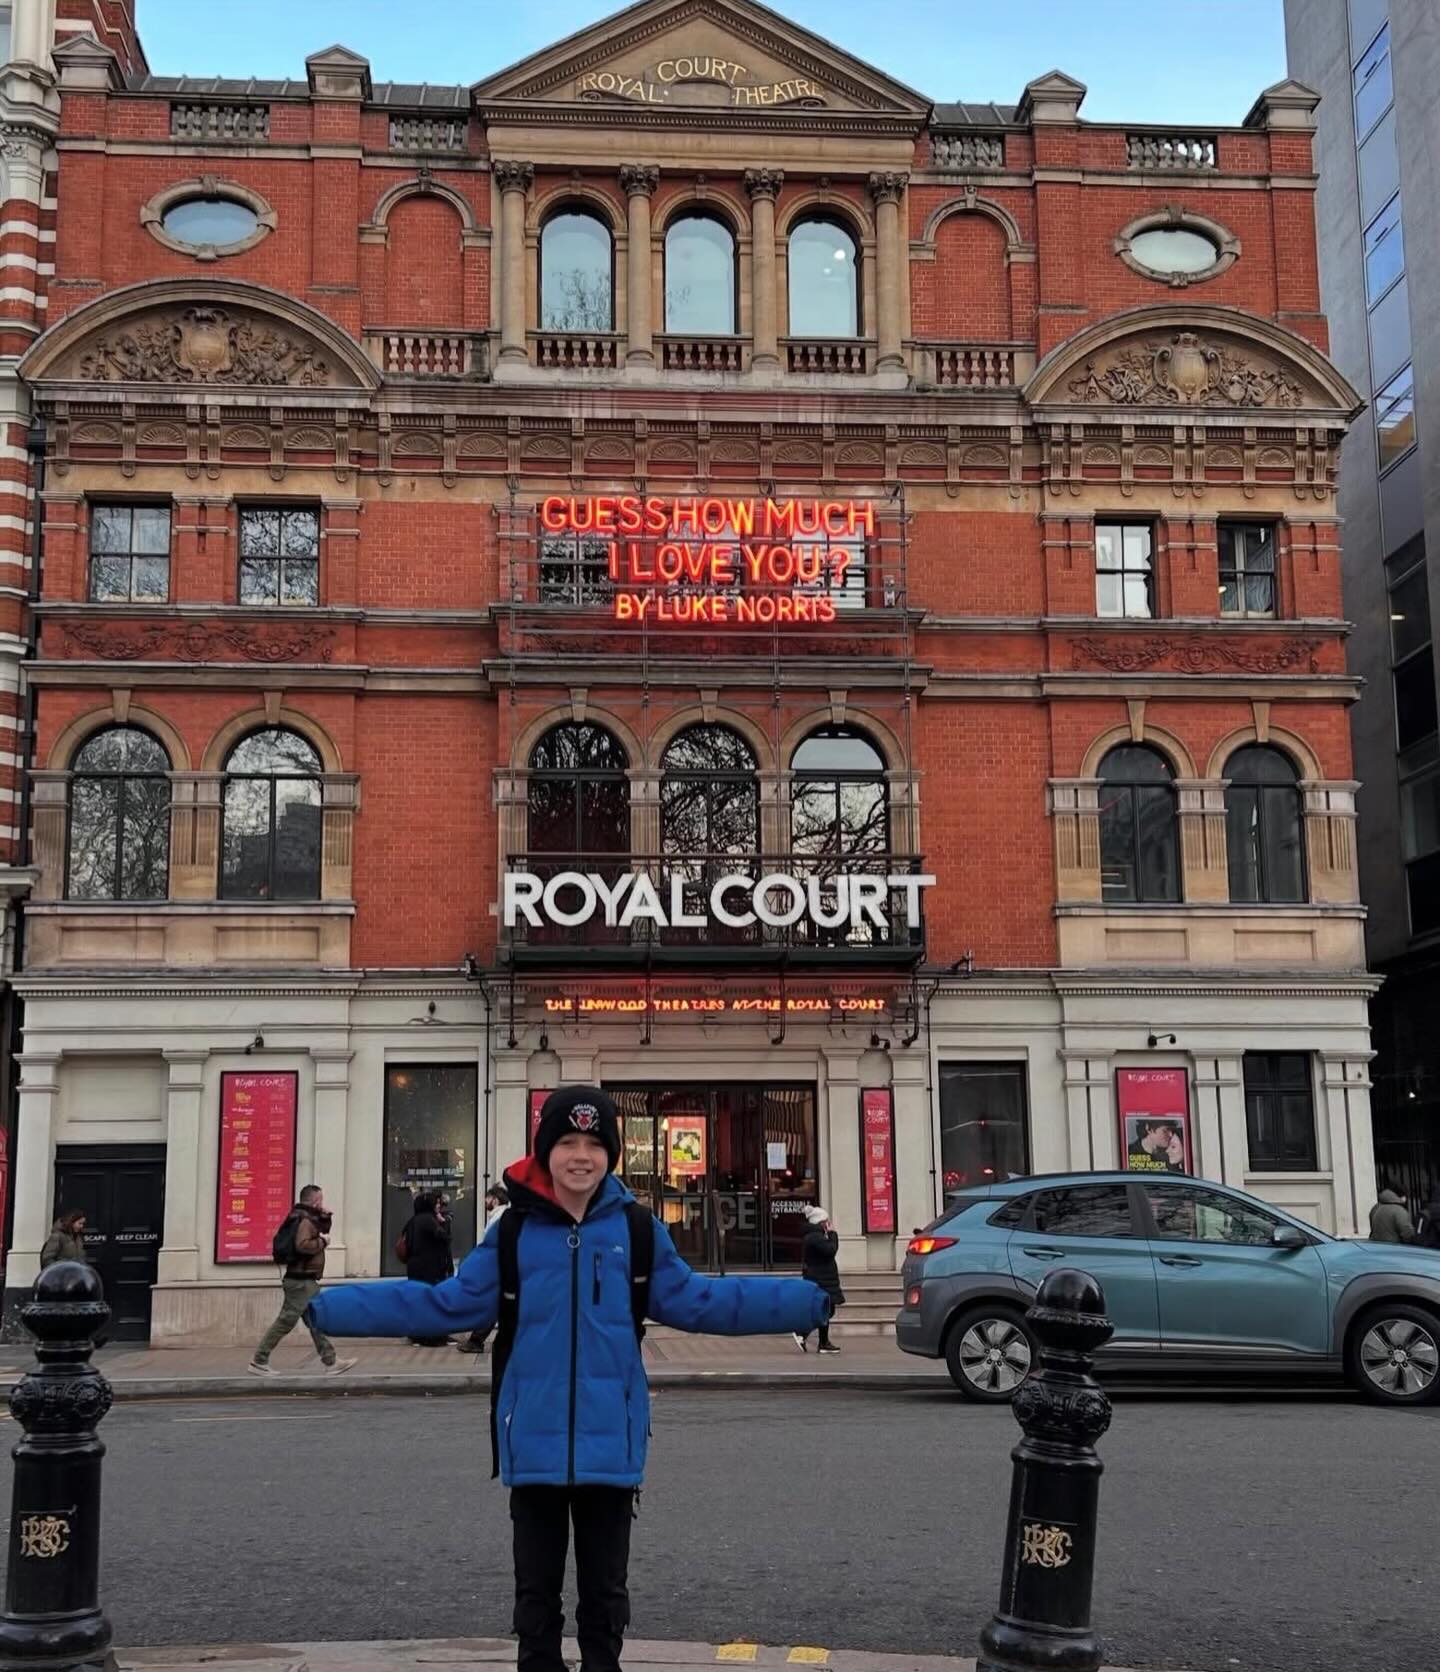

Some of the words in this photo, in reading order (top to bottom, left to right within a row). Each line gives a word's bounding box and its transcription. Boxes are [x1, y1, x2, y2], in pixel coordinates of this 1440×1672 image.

[580, 72, 664, 103] ROYAL
[656, 57, 747, 83] COURT
[733, 79, 824, 105] THEATRE
[541, 495, 667, 533] GUESS
[672, 498, 755, 534] HOW
[765, 498, 875, 536] MUCH
[607, 541, 619, 580] I
[630, 541, 735, 582] LOVE
[616, 593, 647, 620] BY
[658, 595, 728, 621] LUKE
[736, 596, 836, 622] NORRIS
[504, 872, 708, 928] ROYAL
[709, 873, 937, 928] COURT
[545, 999, 571, 1010] THE
[787, 1000, 831, 1011] ROYAL
[839, 1000, 885, 1011] COURT
[83, 1234, 107, 1242] SCAPE
[115, 1233, 134, 1241] KEEP
[134, 1233, 158, 1241] CLEAR
